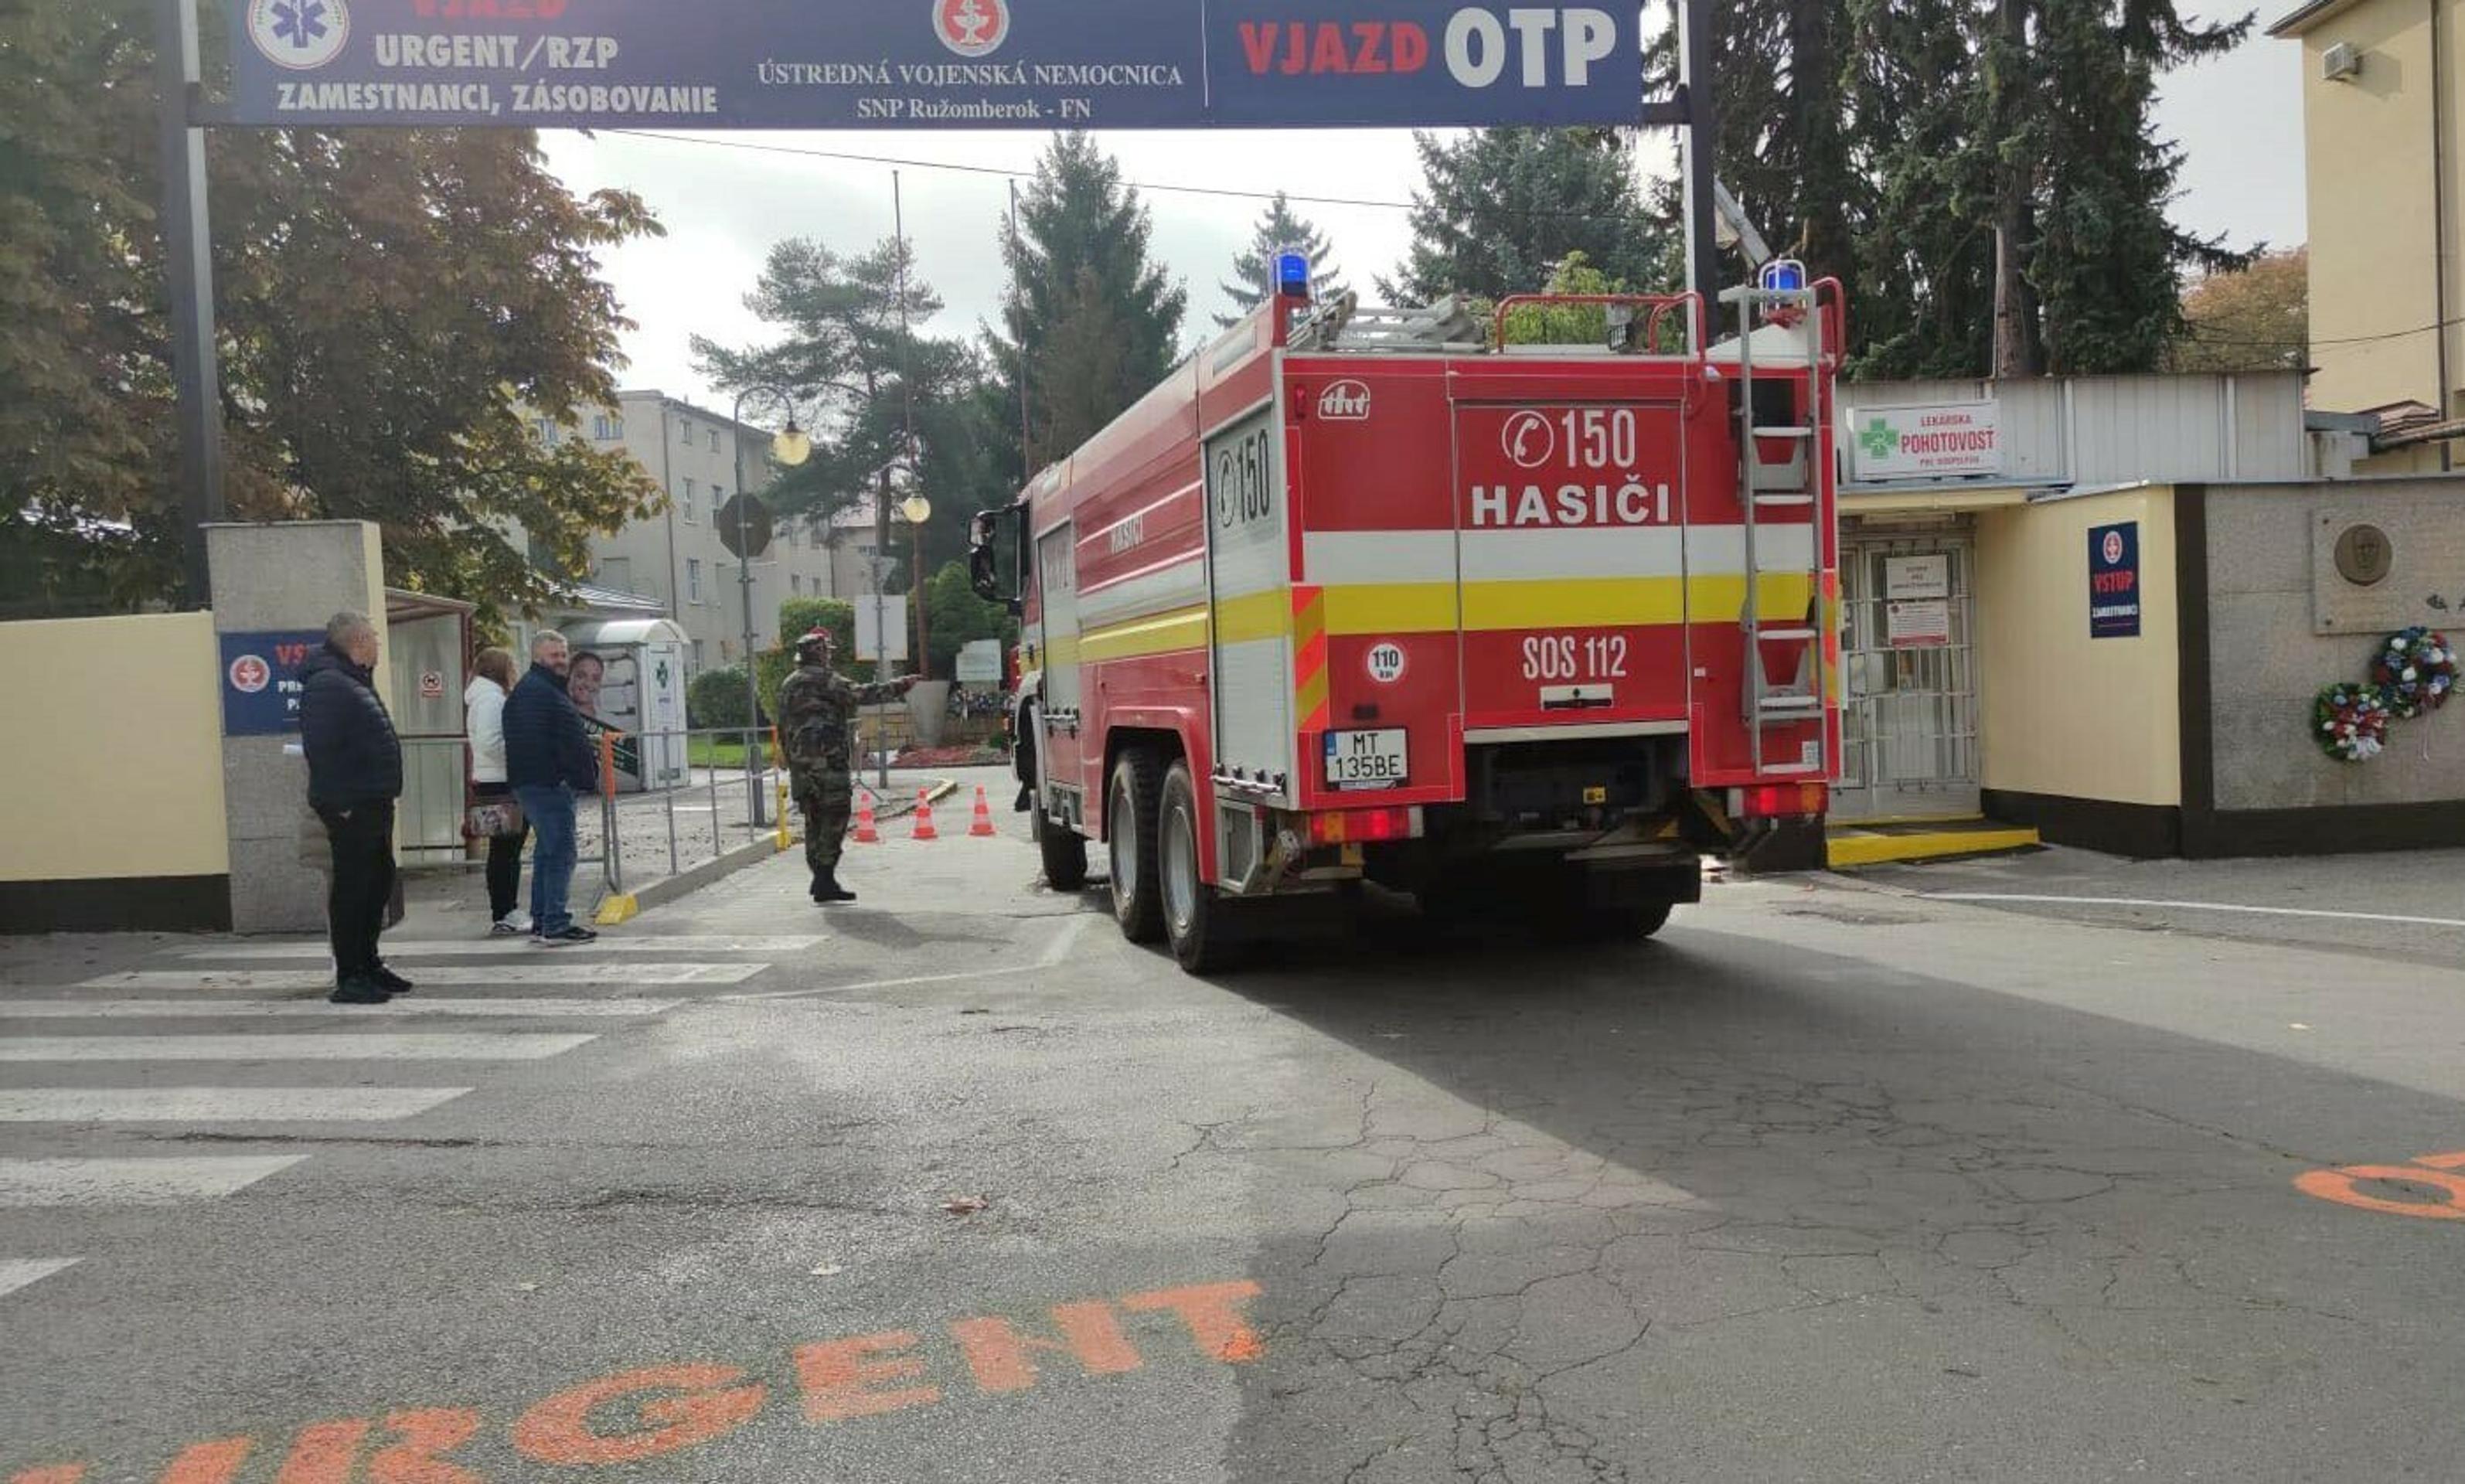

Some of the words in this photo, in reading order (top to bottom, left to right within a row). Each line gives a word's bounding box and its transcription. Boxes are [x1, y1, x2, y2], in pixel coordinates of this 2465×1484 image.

[375, 35, 618, 70] URGENT/RZP
[1240, 21, 1429, 75] VJAZD
[1445, 8, 1616, 87] OTP
[758, 58, 890, 85] ÚSTREDNÁ
[898, 59, 1028, 85] VOJENSKÁ
[1033, 65, 1183, 86] NEMOCNICA
[277, 80, 499, 115] ZAMESTNANCI,
[511, 79, 718, 114] ZÁSOBOVANIE
[857, 98, 903, 118] SNP
[909, 97, 1040, 119] Ružomberok
[1060, 99, 1091, 119] FN
[1561, 410, 1635, 468] 150
[1238, 429, 1269, 523] 150
[1472, 474, 1670, 525] HASIČI
[2094, 570, 2133, 593] VSTUP
[1372, 649, 1399, 669] 110
[1522, 636, 1576, 679] SOS
[1584, 636, 1627, 677] 112
[1353, 733, 1378, 754] MT
[1336, 754, 1401, 779] 135BE
